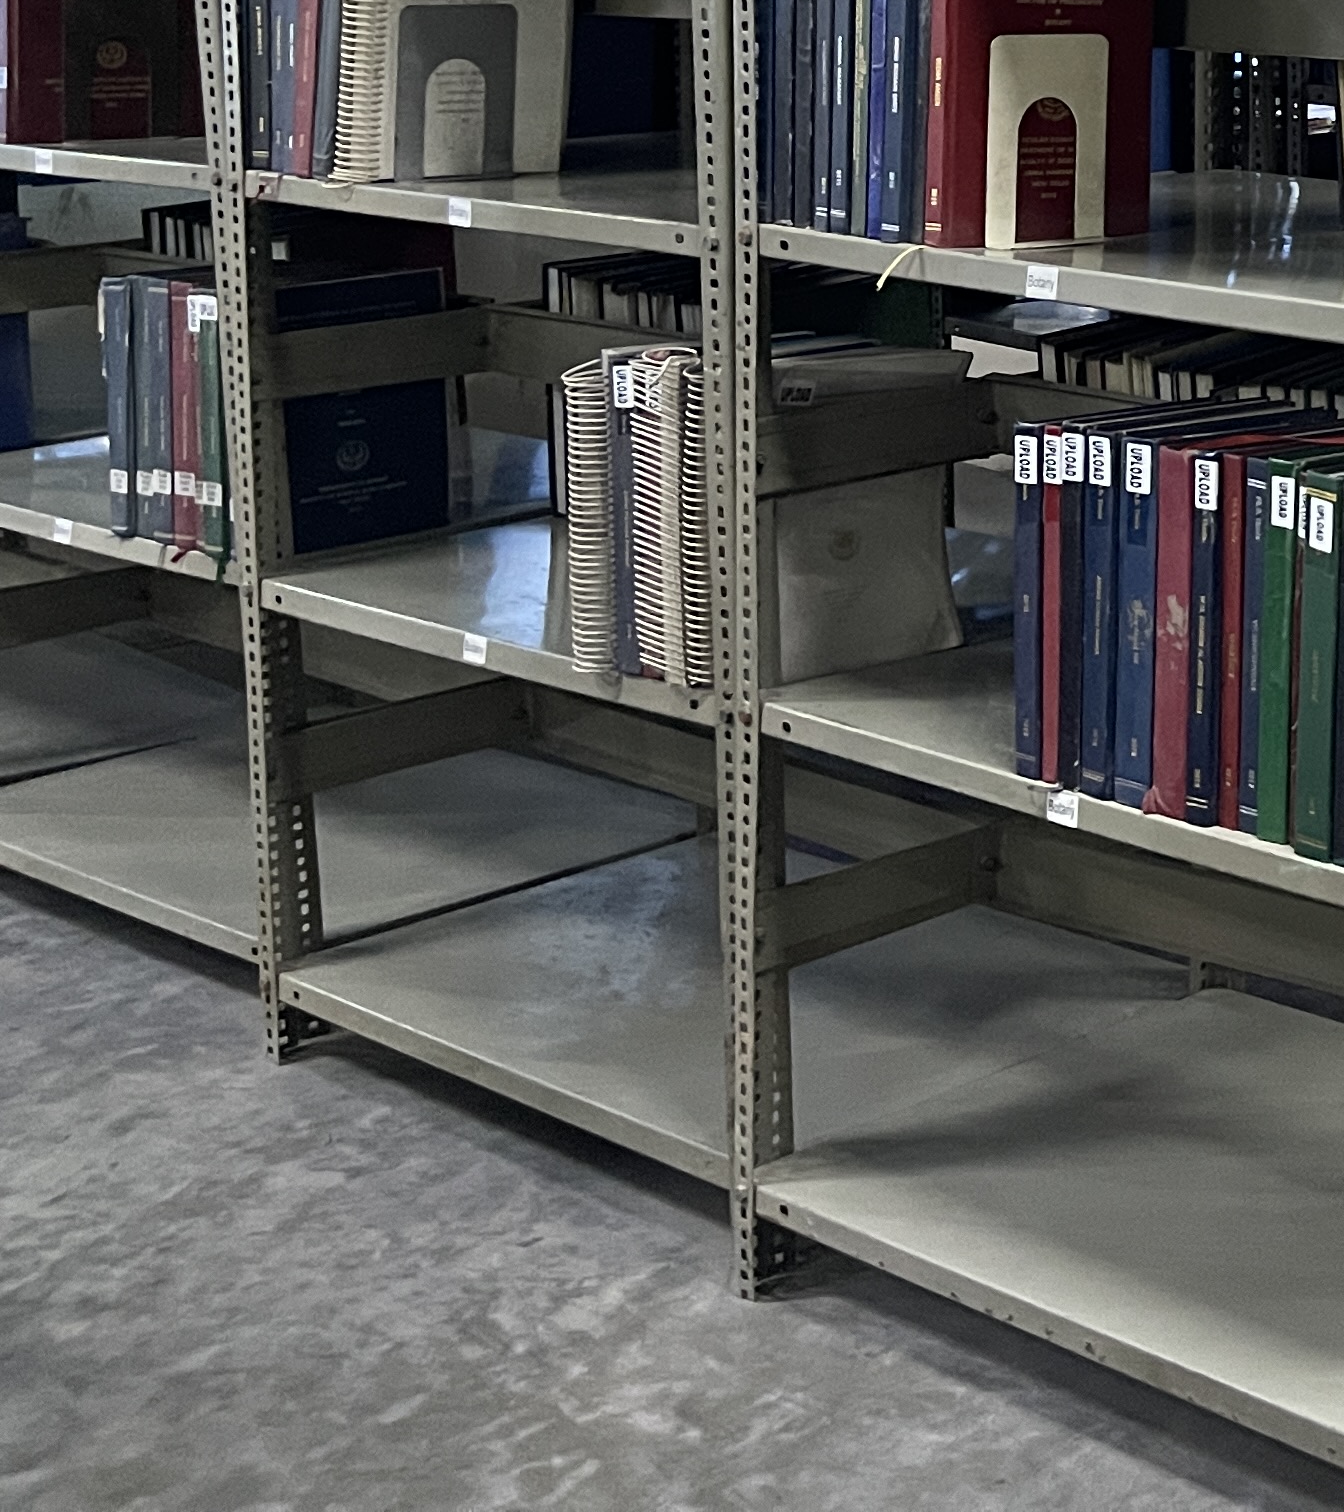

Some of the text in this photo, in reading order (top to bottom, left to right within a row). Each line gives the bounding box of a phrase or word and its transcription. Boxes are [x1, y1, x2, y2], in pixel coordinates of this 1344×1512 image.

[1028, 274, 1055, 293] Botany
[616, 369, 629, 404] UPLOAD
[1019, 439, 1030, 480] UPLOAD
[1045, 439, 1057, 480] UPLOAD
[1064, 437, 1077, 477] UPLOAD
[1093, 440, 1104, 481] UPLOAD
[1129, 447, 1143, 489] UPLOAD
[1198, 463, 1210, 505] UPLOAD
[1278, 481, 1288, 519] UPLOAD
[1316, 504, 1325, 542] UPLOAD
